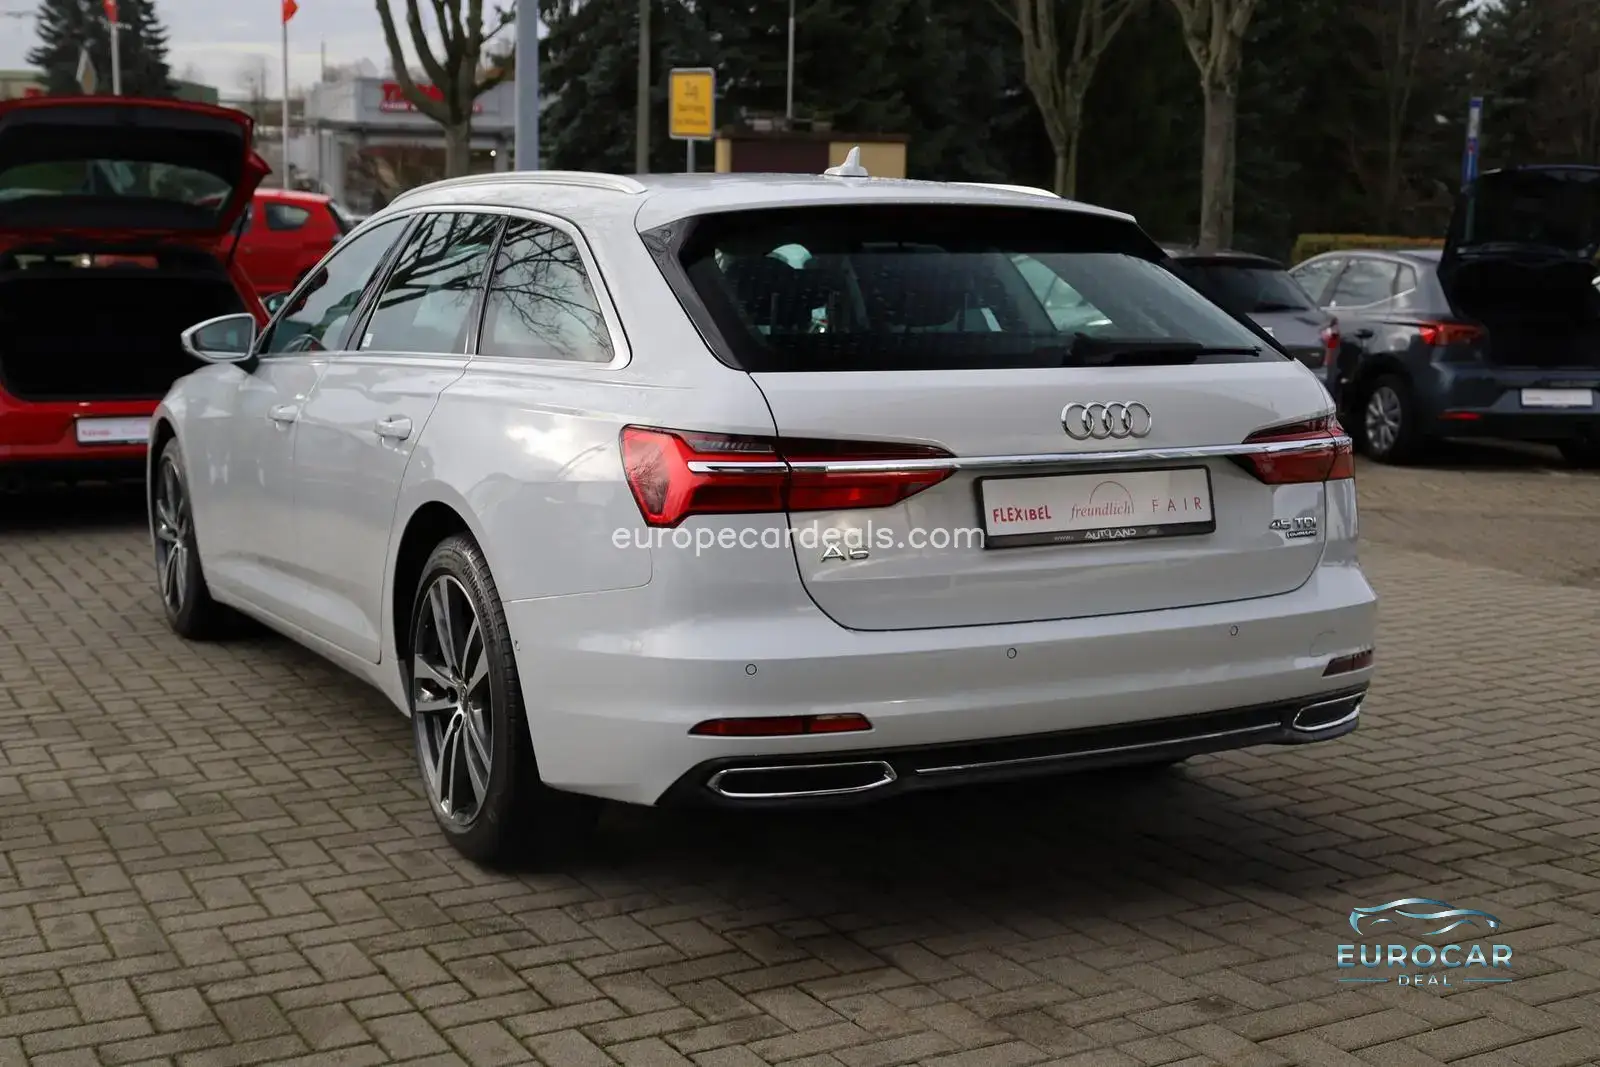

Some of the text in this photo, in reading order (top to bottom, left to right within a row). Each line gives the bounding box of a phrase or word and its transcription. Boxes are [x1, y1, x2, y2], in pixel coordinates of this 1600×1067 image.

[993, 504, 1052, 523] FLEXIBEL
[1069, 500, 1132, 522] freundlich
[1294, 516, 1317, 529] TDI
